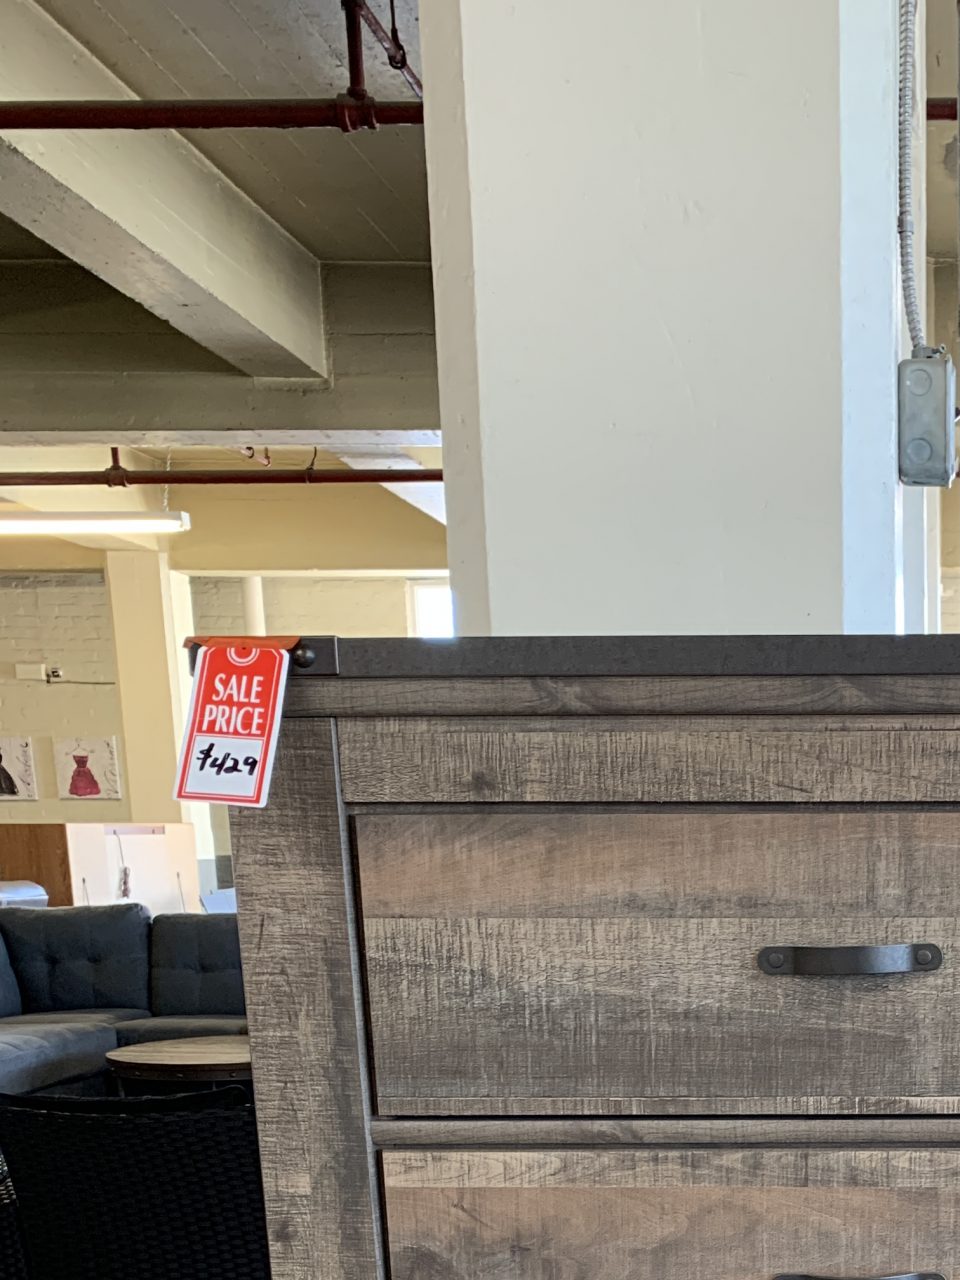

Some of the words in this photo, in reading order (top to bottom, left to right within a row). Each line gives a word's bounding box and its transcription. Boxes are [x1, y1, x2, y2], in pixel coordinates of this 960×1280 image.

[211, 673, 264, 703] SALE
[201, 704, 265, 735] PRICE
[196, 742, 259, 776] $429
